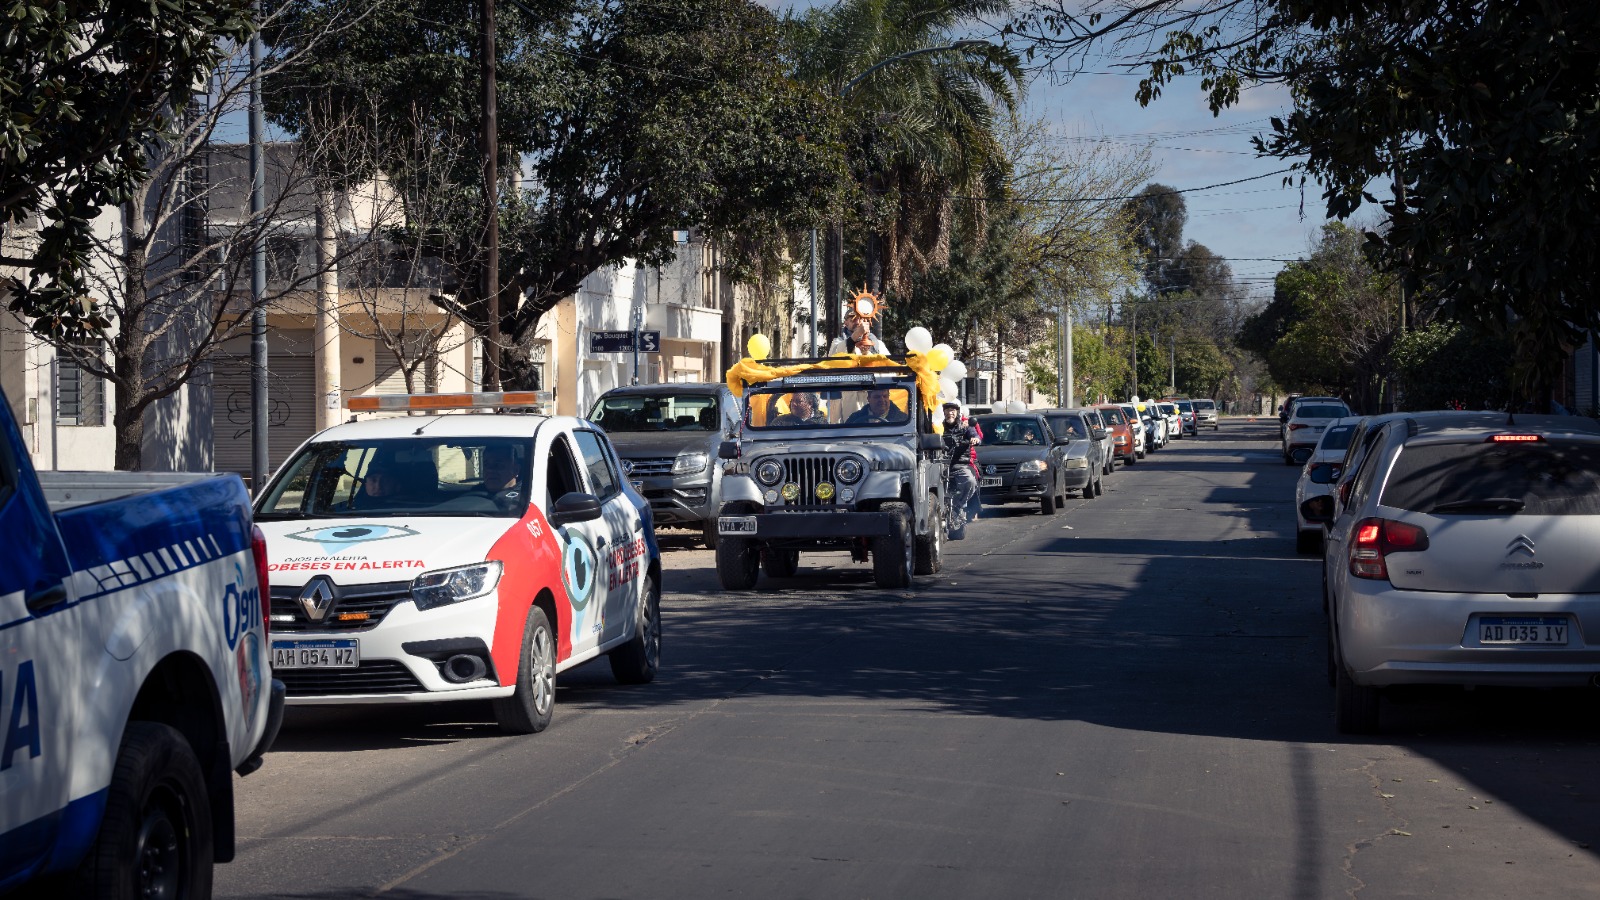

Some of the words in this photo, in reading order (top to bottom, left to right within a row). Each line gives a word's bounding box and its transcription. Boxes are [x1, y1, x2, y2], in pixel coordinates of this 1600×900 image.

[604, 332, 629, 340] Bouquet
[526, 518, 544, 539] 057
[333, 562, 356, 571] EN
[358, 559, 426, 571] ALERTA
[240, 586, 260, 633] 911
[1484, 626, 1504, 641] AD
[1509, 626, 1538, 641] 035
[1544, 626, 1564, 641] IY
[276, 649, 296, 666] AH
[301, 649, 329, 666] 054
[335, 649, 354, 665] WZ
[0, 659, 41, 772] A
